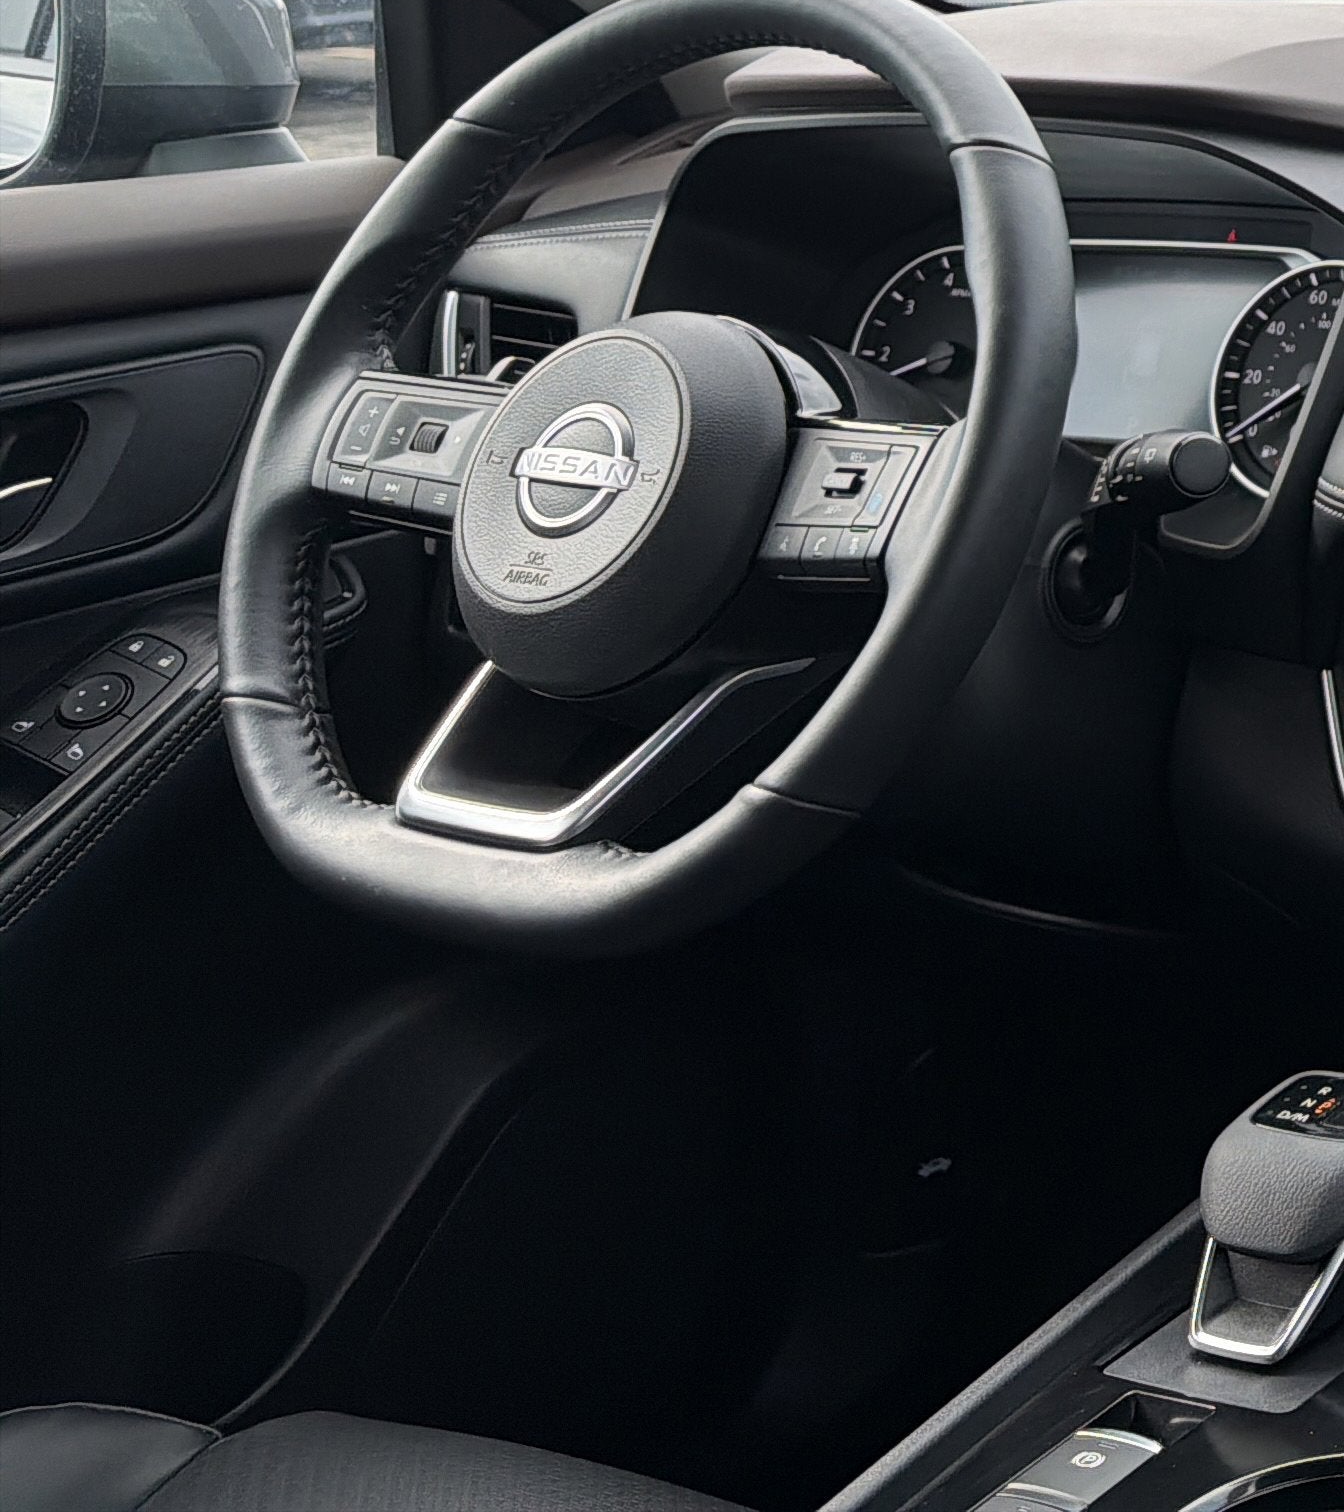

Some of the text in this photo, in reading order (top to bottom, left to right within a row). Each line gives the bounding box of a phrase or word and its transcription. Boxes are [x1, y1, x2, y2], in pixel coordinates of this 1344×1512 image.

[943, 272, 955, 287] 4
[1309, 289, 1328, 305] 60
[903, 298, 916, 316] 3
[1265, 320, 1286, 336] 40
[1318, 319, 1332, 329] 100
[878, 346, 891, 363] 2
[1284, 343, 1296, 354] 60
[1243, 368, 1263, 385] 20
[515, 450, 636, 487] NISSAN
[502, 569, 550, 587] AIRBAG
[1317, 1086, 1333, 1095] R
[1299, 1097, 1317, 1108] N
[1276, 1109, 1310, 1123] D/M
